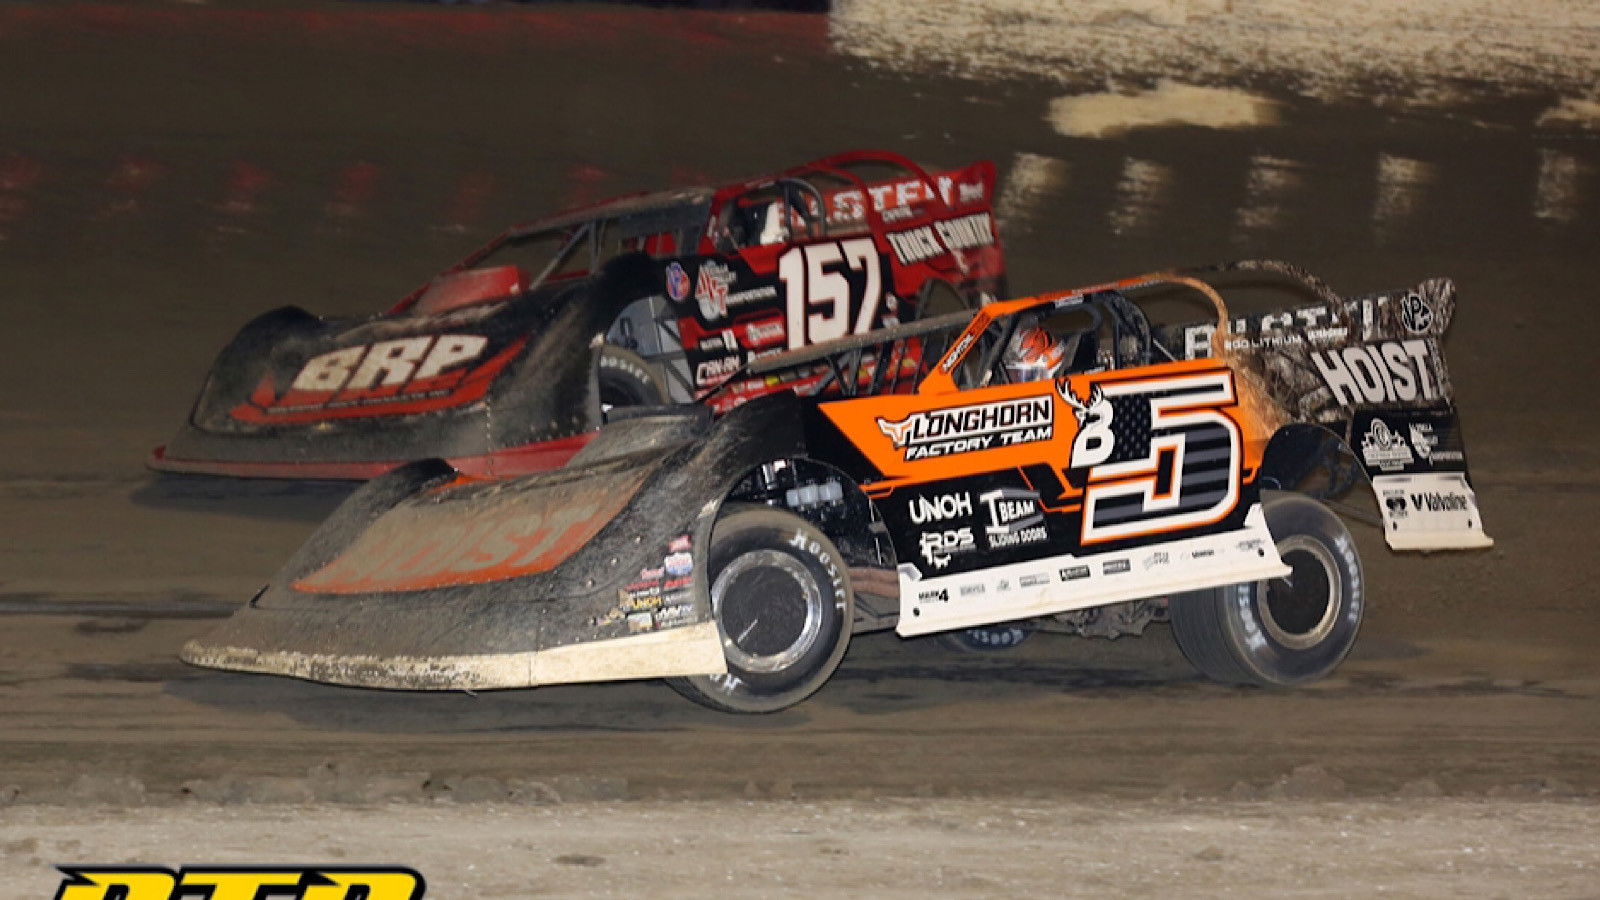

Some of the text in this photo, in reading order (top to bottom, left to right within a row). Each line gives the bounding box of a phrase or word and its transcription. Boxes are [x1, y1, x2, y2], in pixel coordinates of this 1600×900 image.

[779, 238, 882, 350] 157
[291, 334, 488, 391] BRP
[1311, 339, 1431, 406] HOIST
[911, 399, 1051, 441] LONGHORN
[905, 426, 1052, 461] FACTORY TEAM
[909, 490, 973, 524] UNOH
[998, 500, 1036, 523] BEAM
[1020, 526, 1048, 544] DOORS
